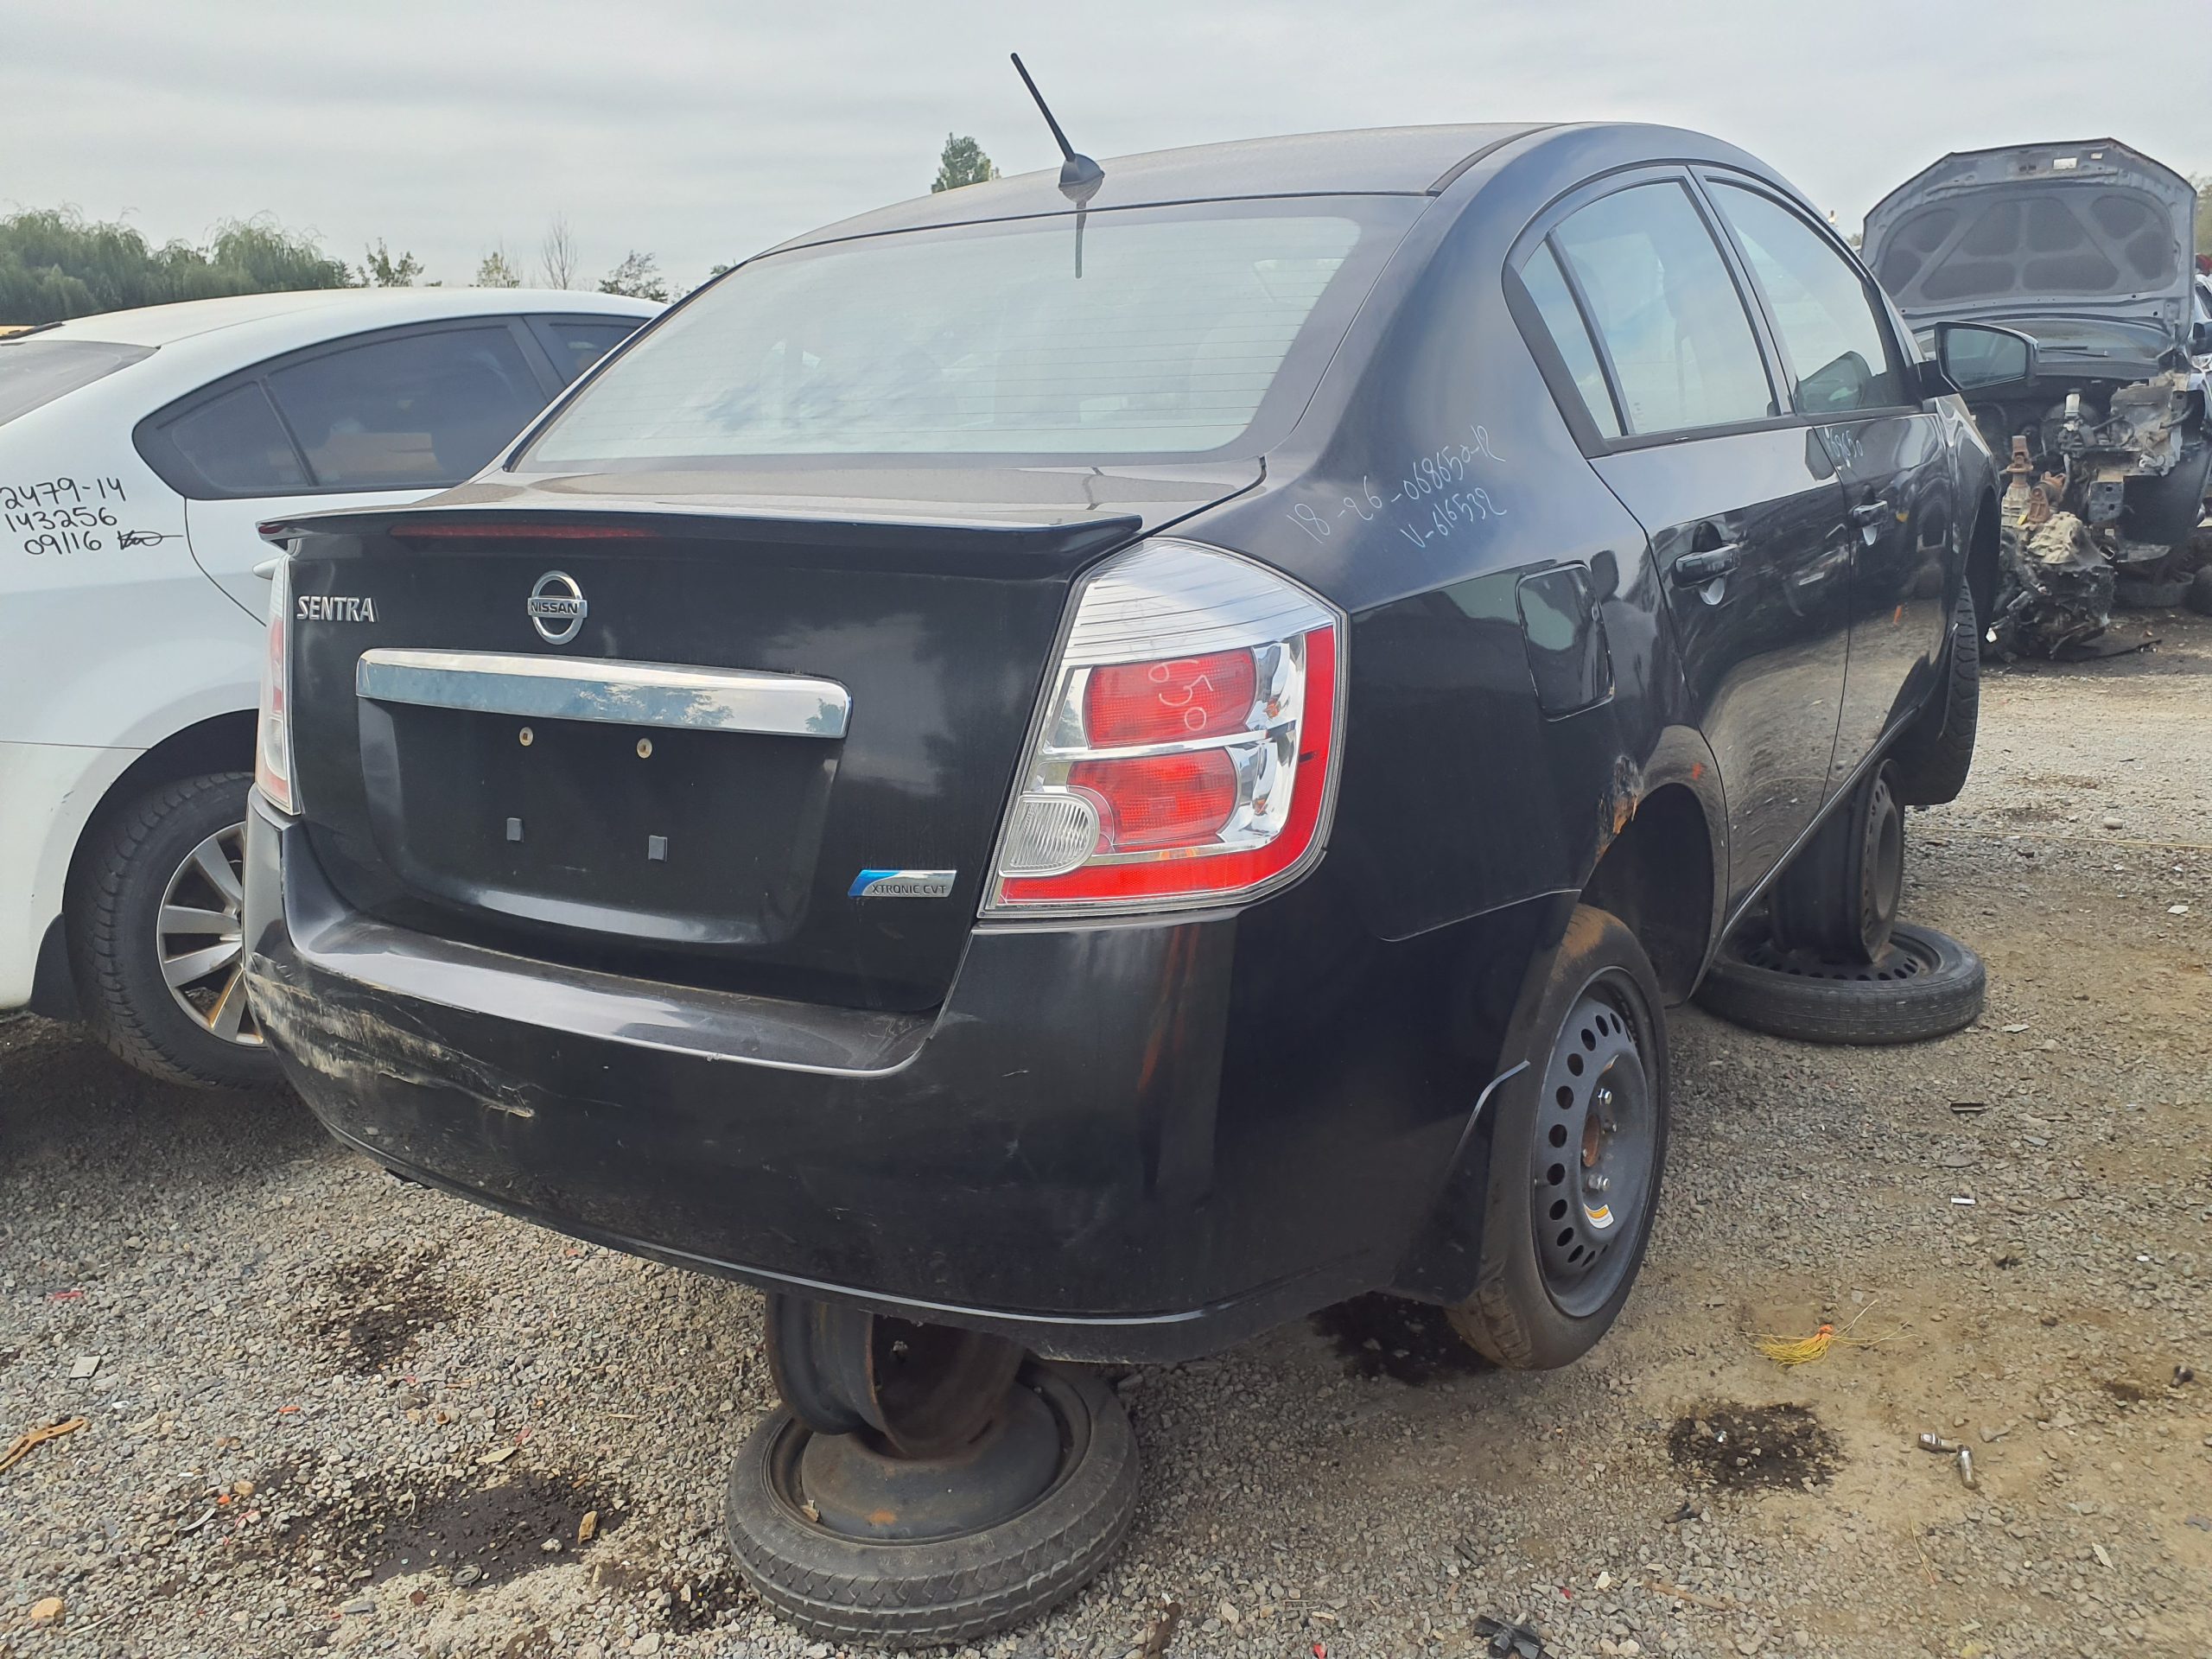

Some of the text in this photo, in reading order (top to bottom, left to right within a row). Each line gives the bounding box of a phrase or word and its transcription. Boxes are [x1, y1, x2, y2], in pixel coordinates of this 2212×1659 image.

[0, 477, 127, 510] 2479-14
[4, 506, 118, 532] 143256
[296, 595, 376, 623] SENTRA
[530, 601, 579, 614] NISSAN
[871, 884, 947, 895] XTRONIC CVT
